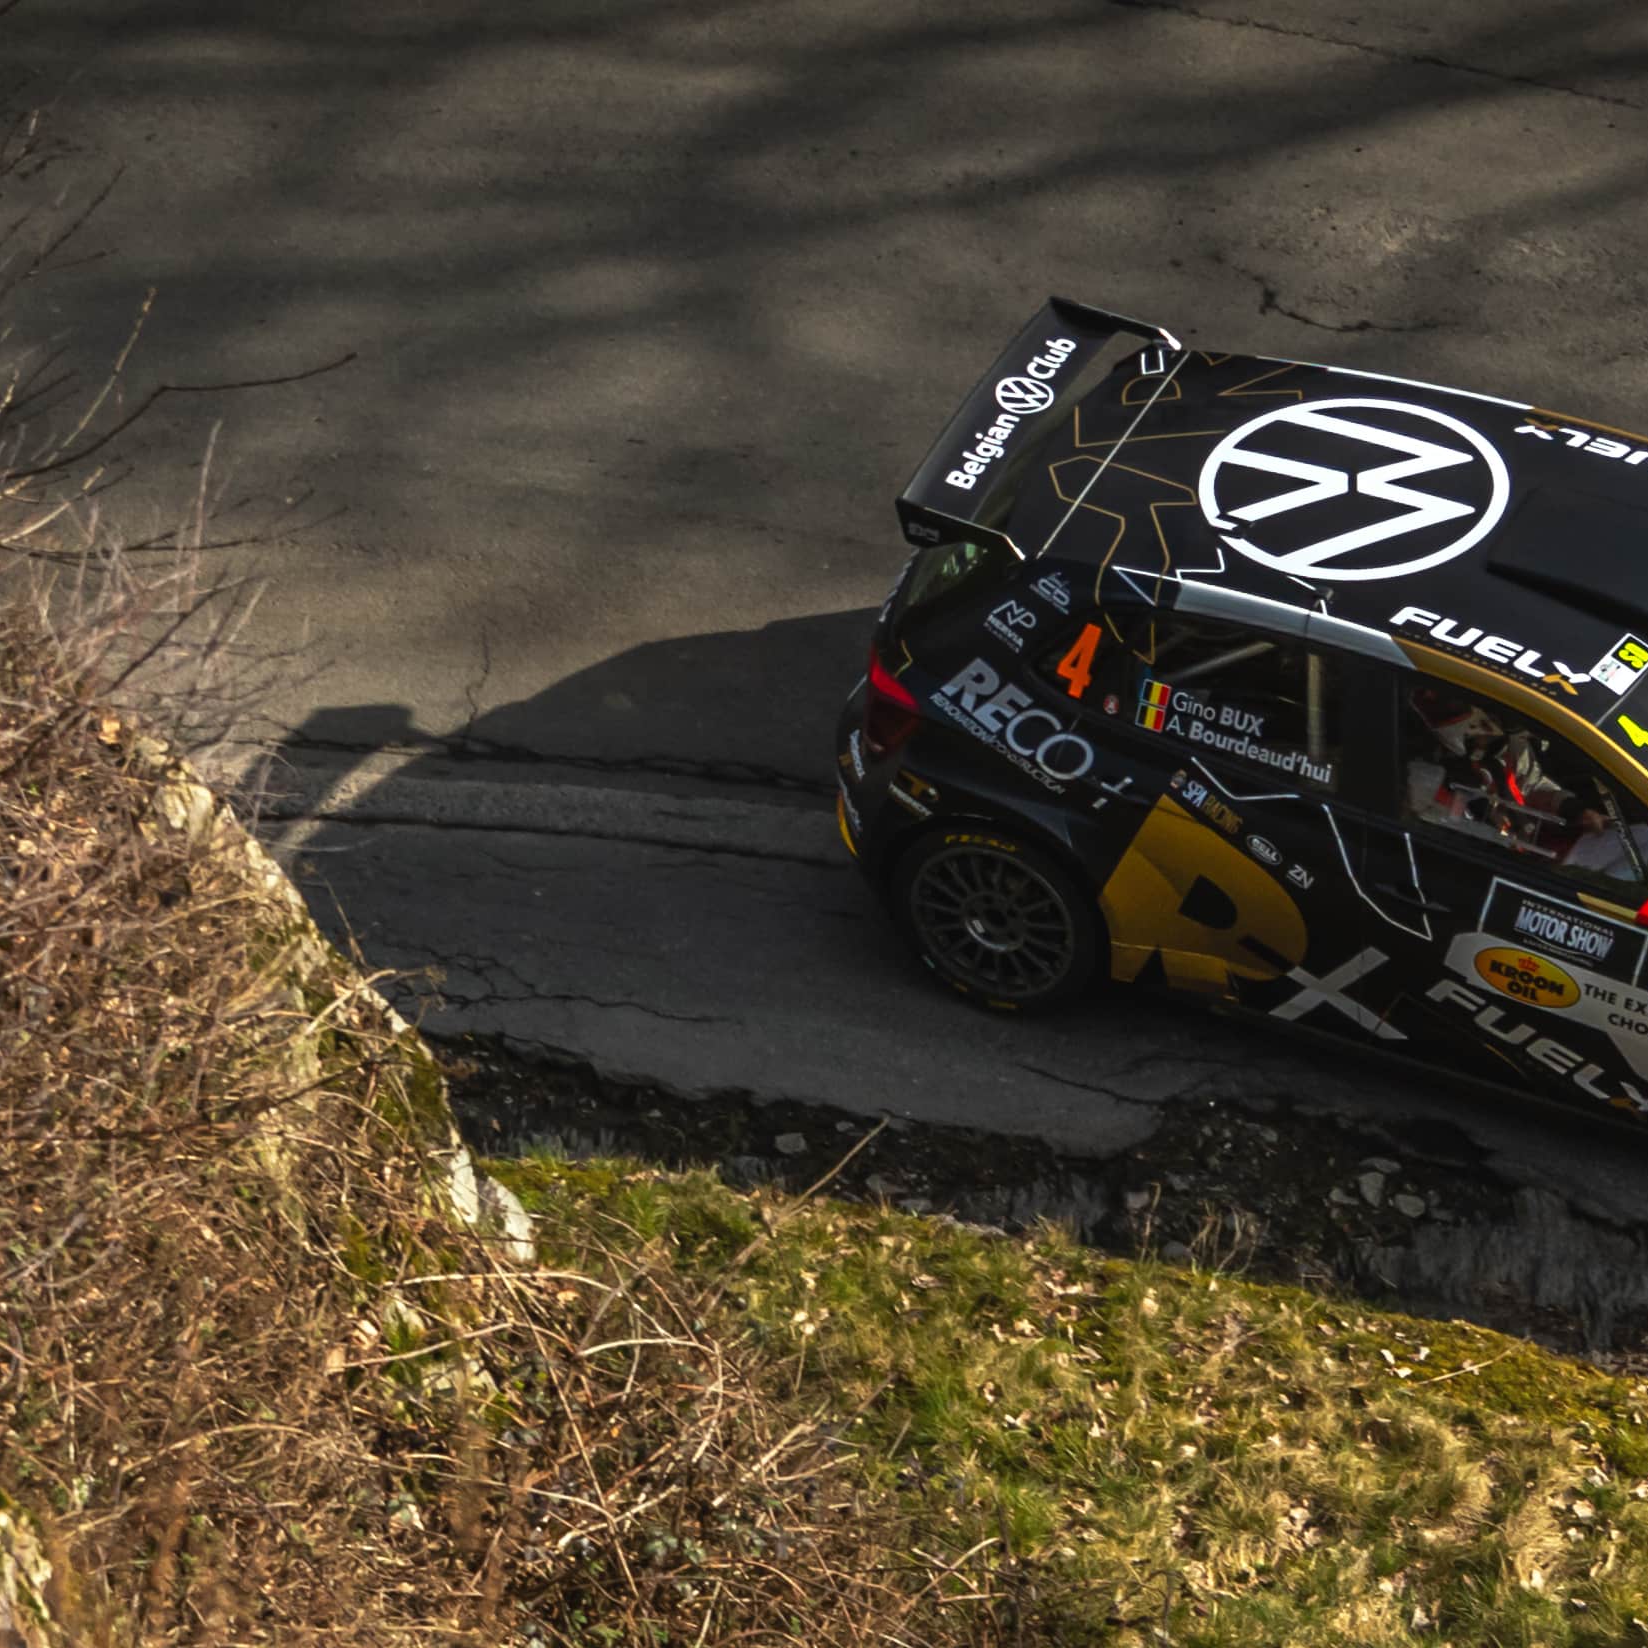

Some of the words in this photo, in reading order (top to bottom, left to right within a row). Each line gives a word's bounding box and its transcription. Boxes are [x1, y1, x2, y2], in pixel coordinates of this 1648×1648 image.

[944, 413, 1020, 490] Belgian
[1026, 337, 1078, 380] Club
[1056, 622, 1102, 699] 4
[1388, 604, 1593, 697] FUELX
[1171, 691, 1216, 721] Gino
[1219, 706, 1264, 737] BUX
[1165, 715, 1185, 737] A.
[1188, 723, 1333, 784] Bourdeaud'hui
[1514, 906, 1567, 947] MOTOR
[1565, 925, 1614, 961] SHOW
[1521, 899, 1614, 937] INTERNATIONAL
[1488, 959, 1565, 997] KROON
[1506, 981, 1539, 1003] OIL
[1582, 983, 1617, 1007] THE
